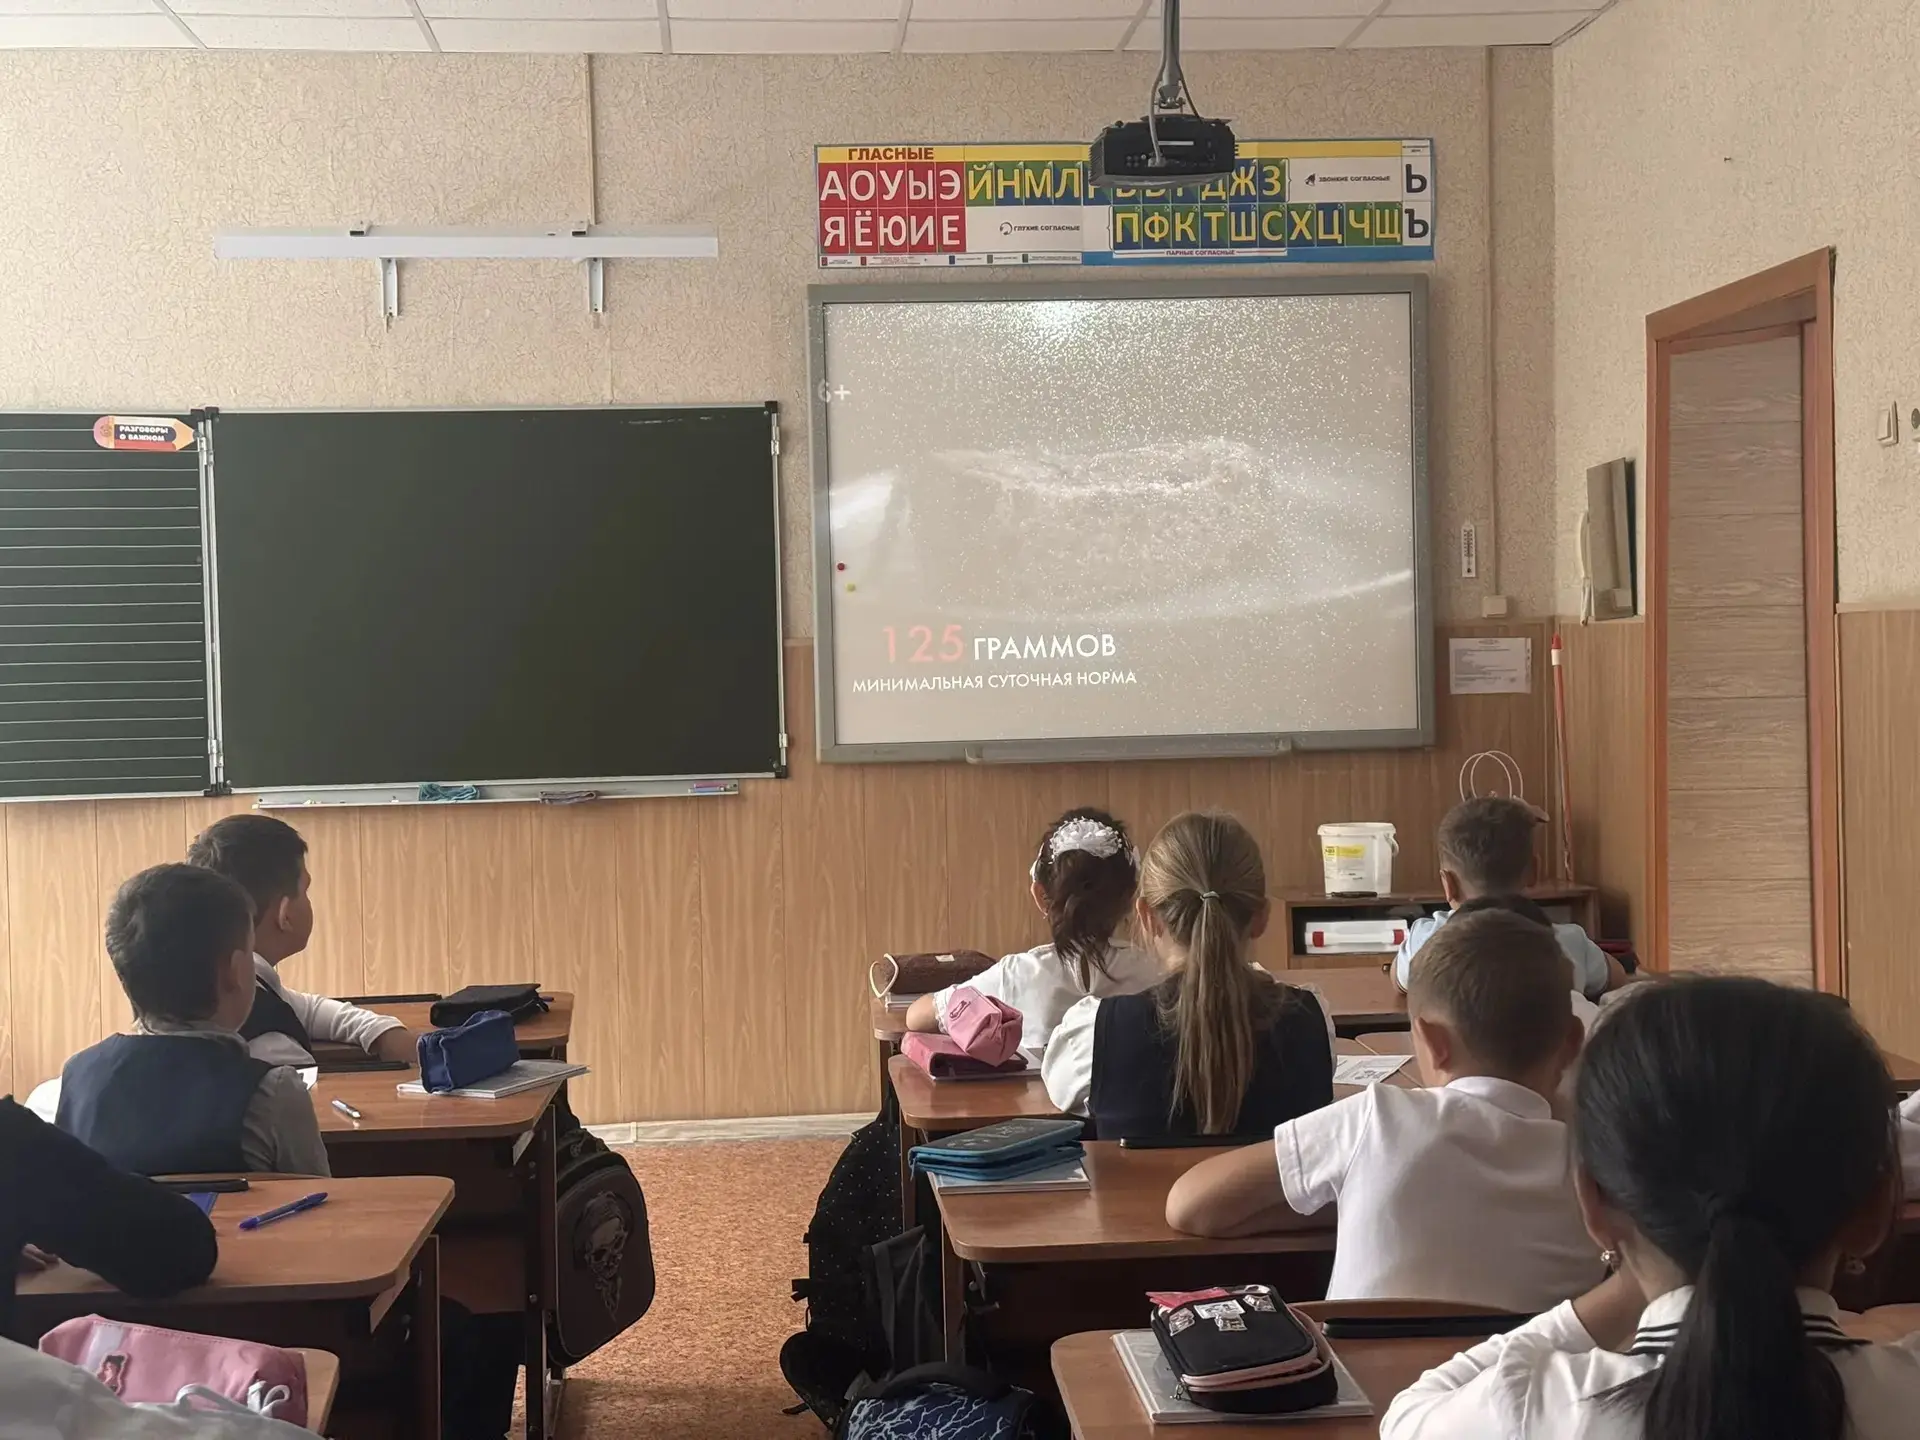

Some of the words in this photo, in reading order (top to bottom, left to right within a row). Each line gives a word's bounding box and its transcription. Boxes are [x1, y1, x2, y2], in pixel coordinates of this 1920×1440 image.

[848, 147, 934, 161] ГЛАСНЫЕ
[1405, 164, 1427, 193] Ь
[1404, 208, 1429, 238] Ъ
[119, 425, 168, 434] РАЗГОВОРЫ
[883, 624, 965, 663] 125
[974, 633, 1116, 660] ГРАММОВ
[853, 675, 983, 692] МИНИМАЛЬНАЯ
[988, 672, 1073, 688] СУТОЧНАЯ
[1077, 670, 1137, 685] НОРМА
